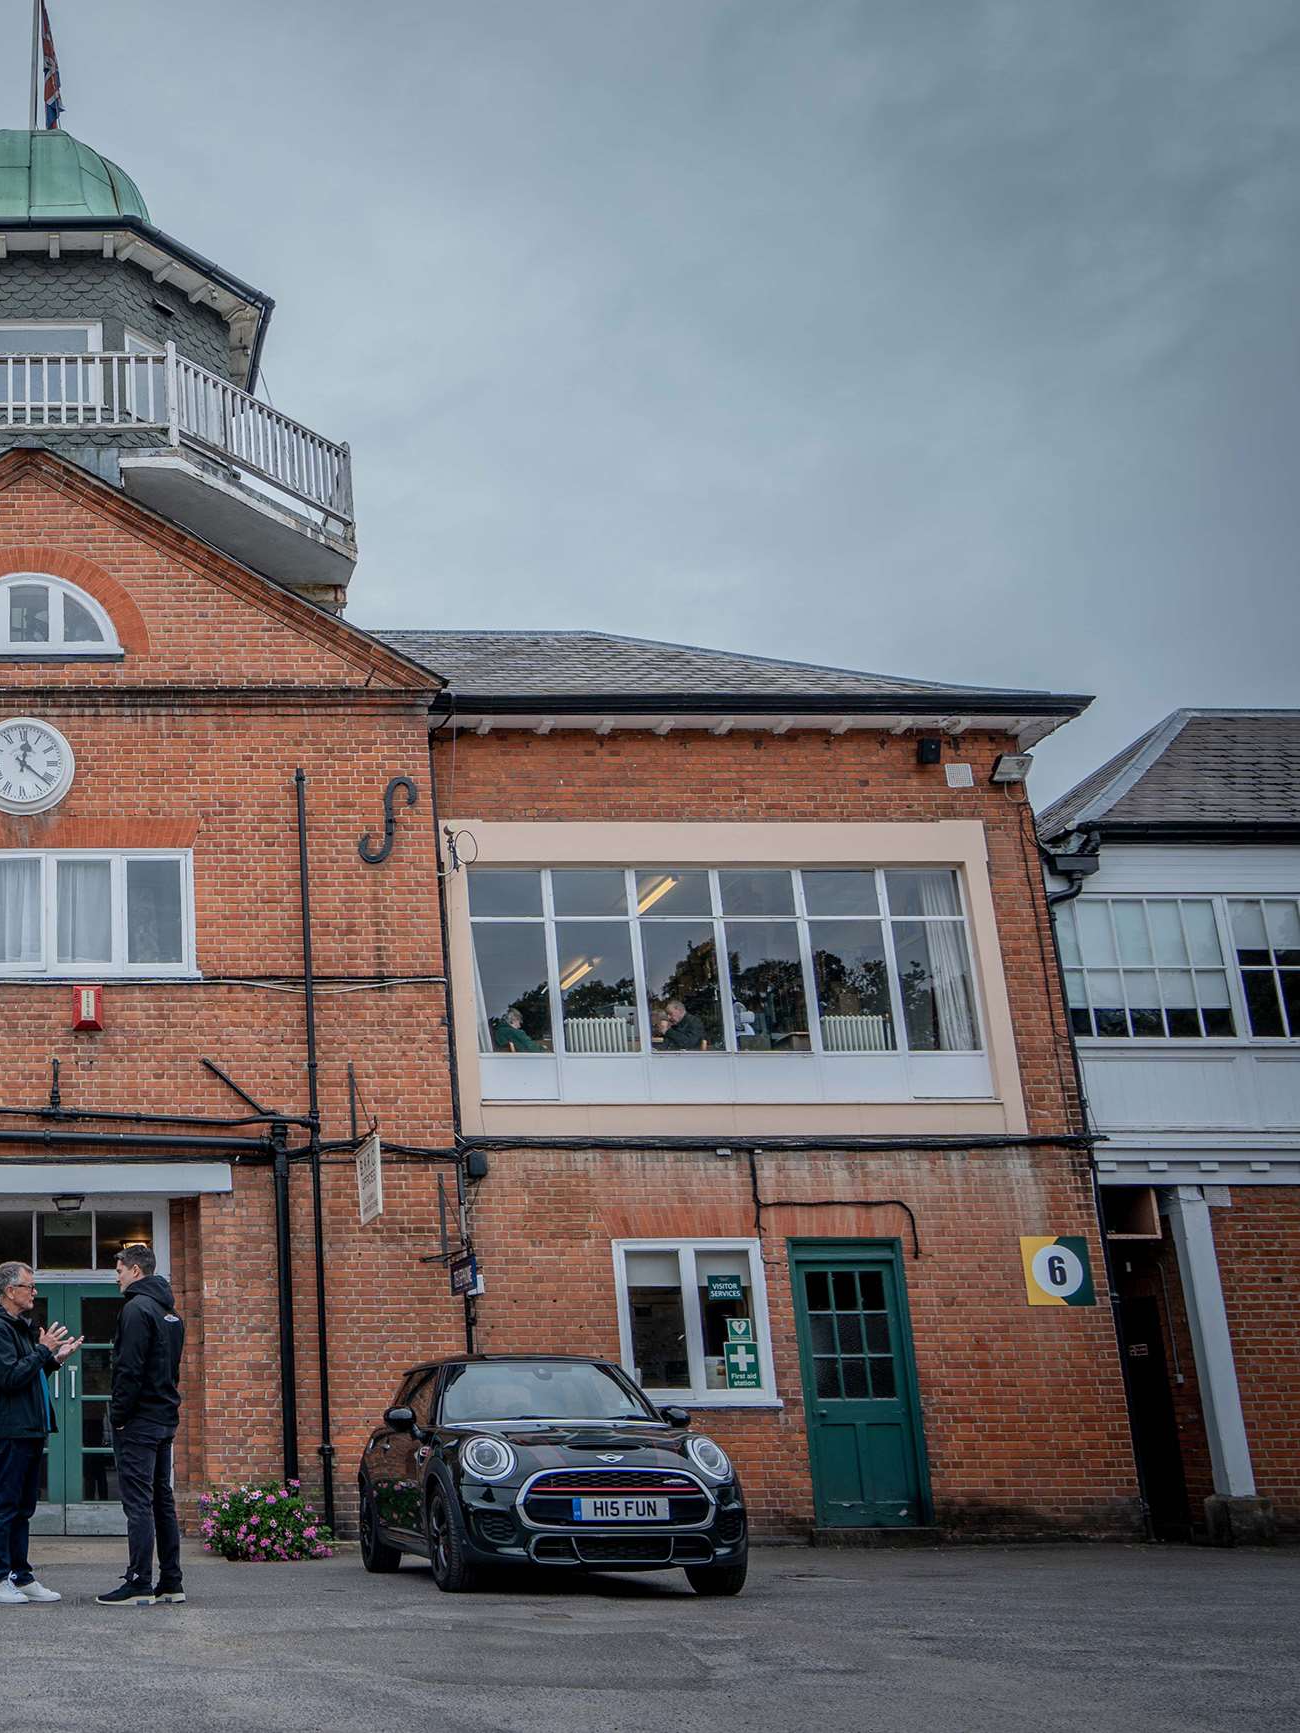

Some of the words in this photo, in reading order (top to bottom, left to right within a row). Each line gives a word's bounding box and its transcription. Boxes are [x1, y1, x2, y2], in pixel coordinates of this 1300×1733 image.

[1047, 1255, 1067, 1286] 6
[593, 1500, 620, 1517] H15
[624, 1500, 657, 1517] FUN
